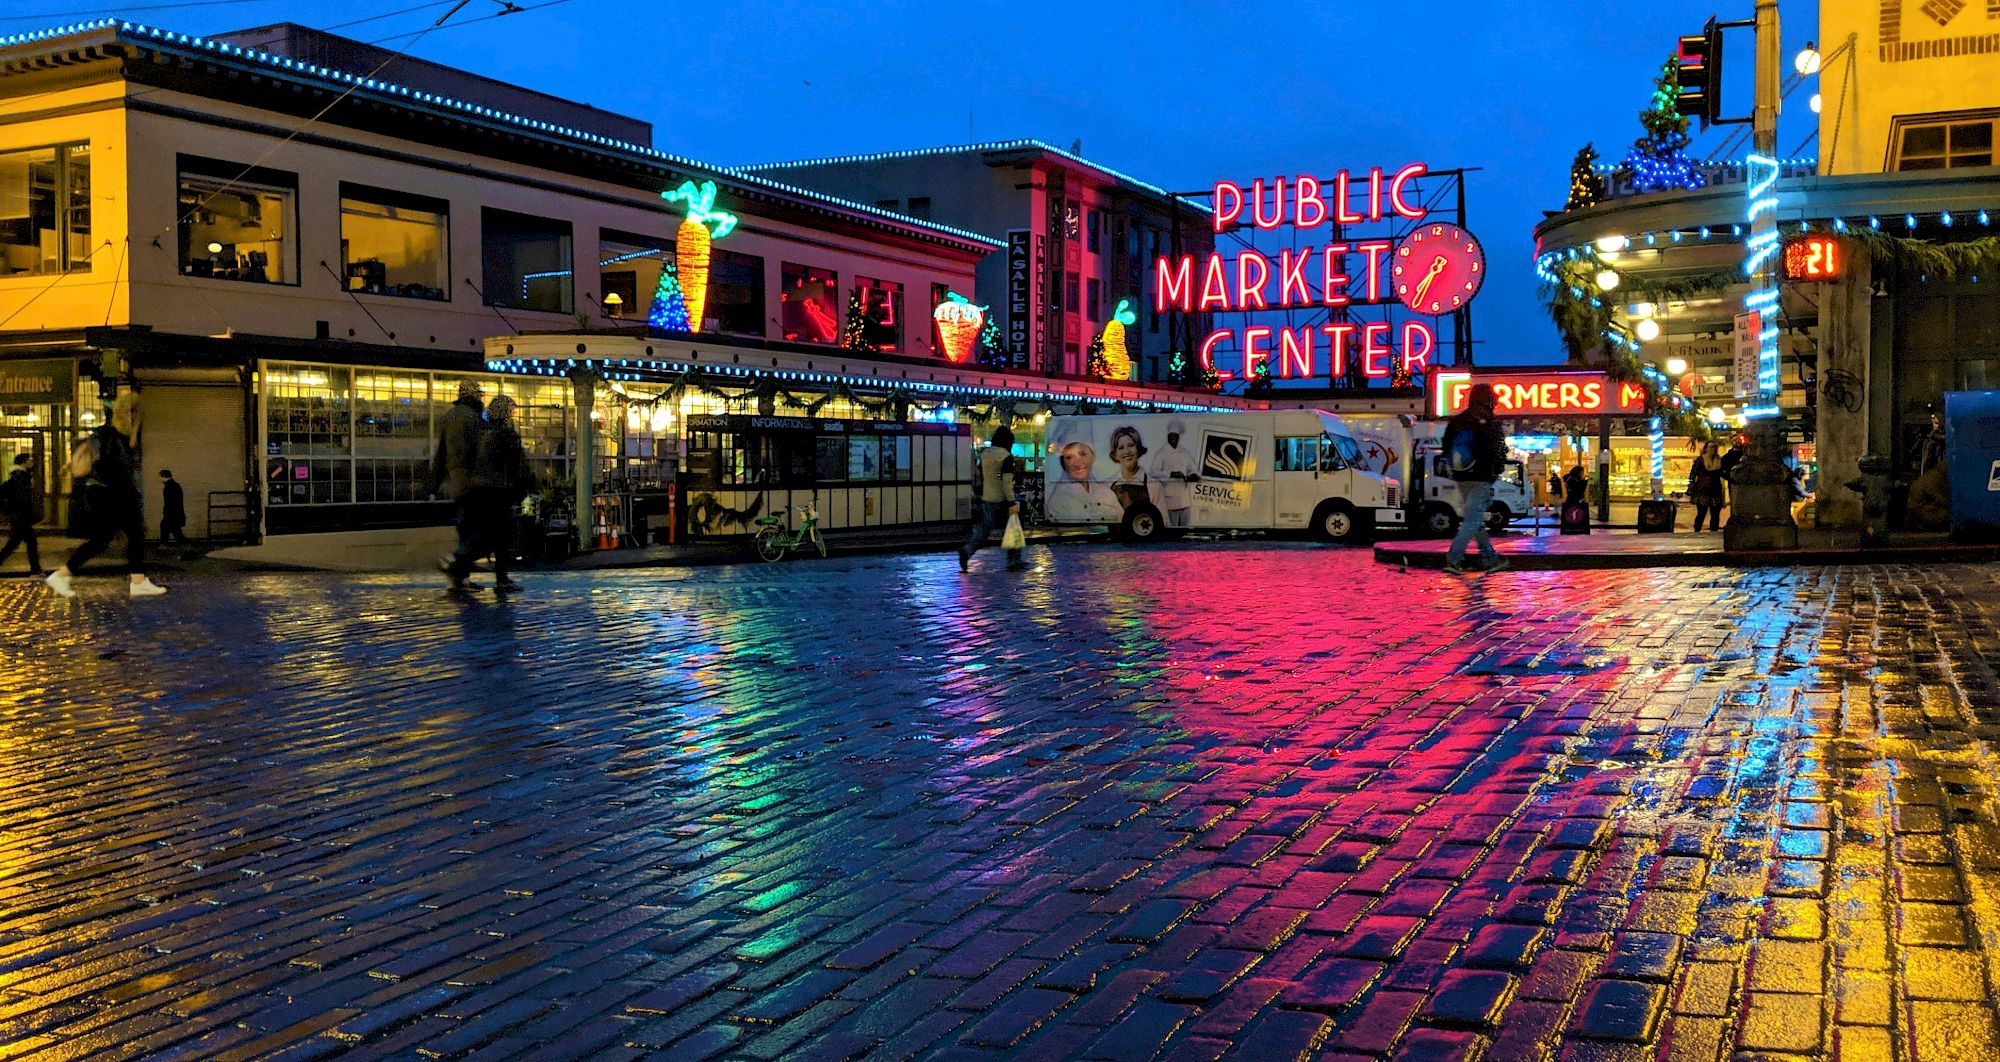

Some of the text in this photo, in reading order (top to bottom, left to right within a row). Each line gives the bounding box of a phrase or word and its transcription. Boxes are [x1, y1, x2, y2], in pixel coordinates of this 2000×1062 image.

[1214, 163, 1426, 232] PUBLIC
[1431, 226, 1443, 236] 12
[1413, 233, 1422, 242] 11
[1012, 234, 1026, 255] LA
[1037, 236, 1044, 258] LA
[1466, 243, 1474, 253] 2
[1399, 247, 1410, 257] 10
[1807, 241, 1834, 274] 21
[1394, 266, 1403, 276] 9
[1471, 261, 1479, 272] 3
[1157, 243, 1391, 312] MARKET
[1011, 259, 1026, 313] SALLE
[1036, 263, 1044, 316] SALLE
[1399, 285, 1407, 294] 8
[1465, 281, 1473, 291] 4
[1431, 301, 1440, 311] 6
[1452, 295, 1460, 305] 5
[1202, 322, 1434, 380] CENTER
[1452, 382, 1602, 410] FRMERS
[751, 417, 804, 429] INFORMATION
[1194, 484, 1243, 501] SERVICE
[1192, 494, 1242, 507] LINEN SUPPLY
